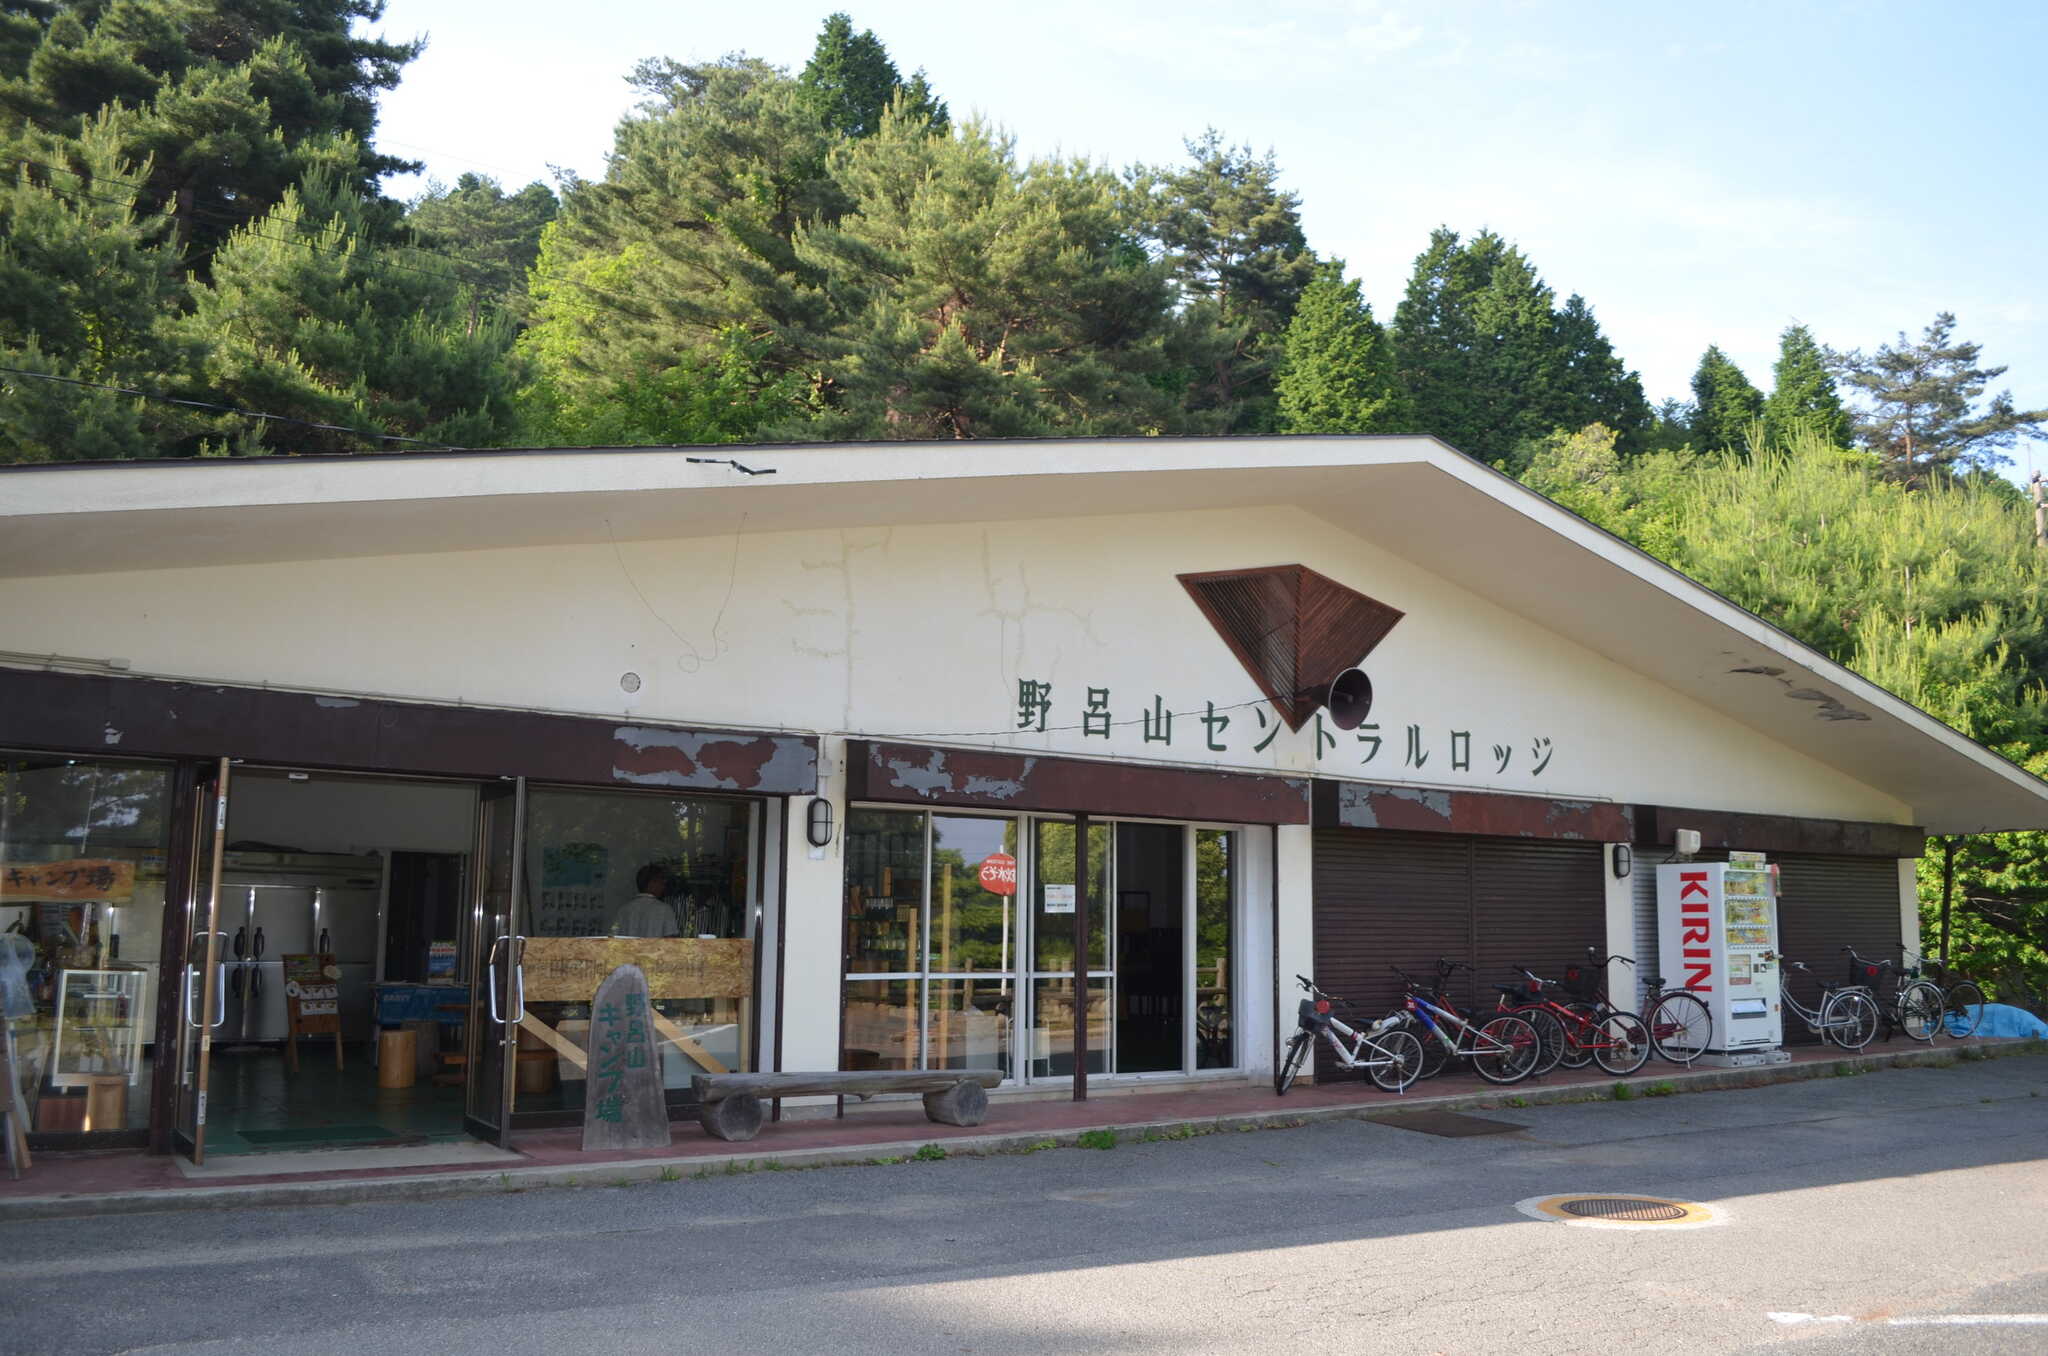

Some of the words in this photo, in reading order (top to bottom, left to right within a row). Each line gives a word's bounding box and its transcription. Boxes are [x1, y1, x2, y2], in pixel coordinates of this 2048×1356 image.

[1017, 678, 1553, 777] 野呂山セントラルロッジ
[1680, 872, 1712, 992] KIRIN
[624, 992, 646, 1069] 野呂山
